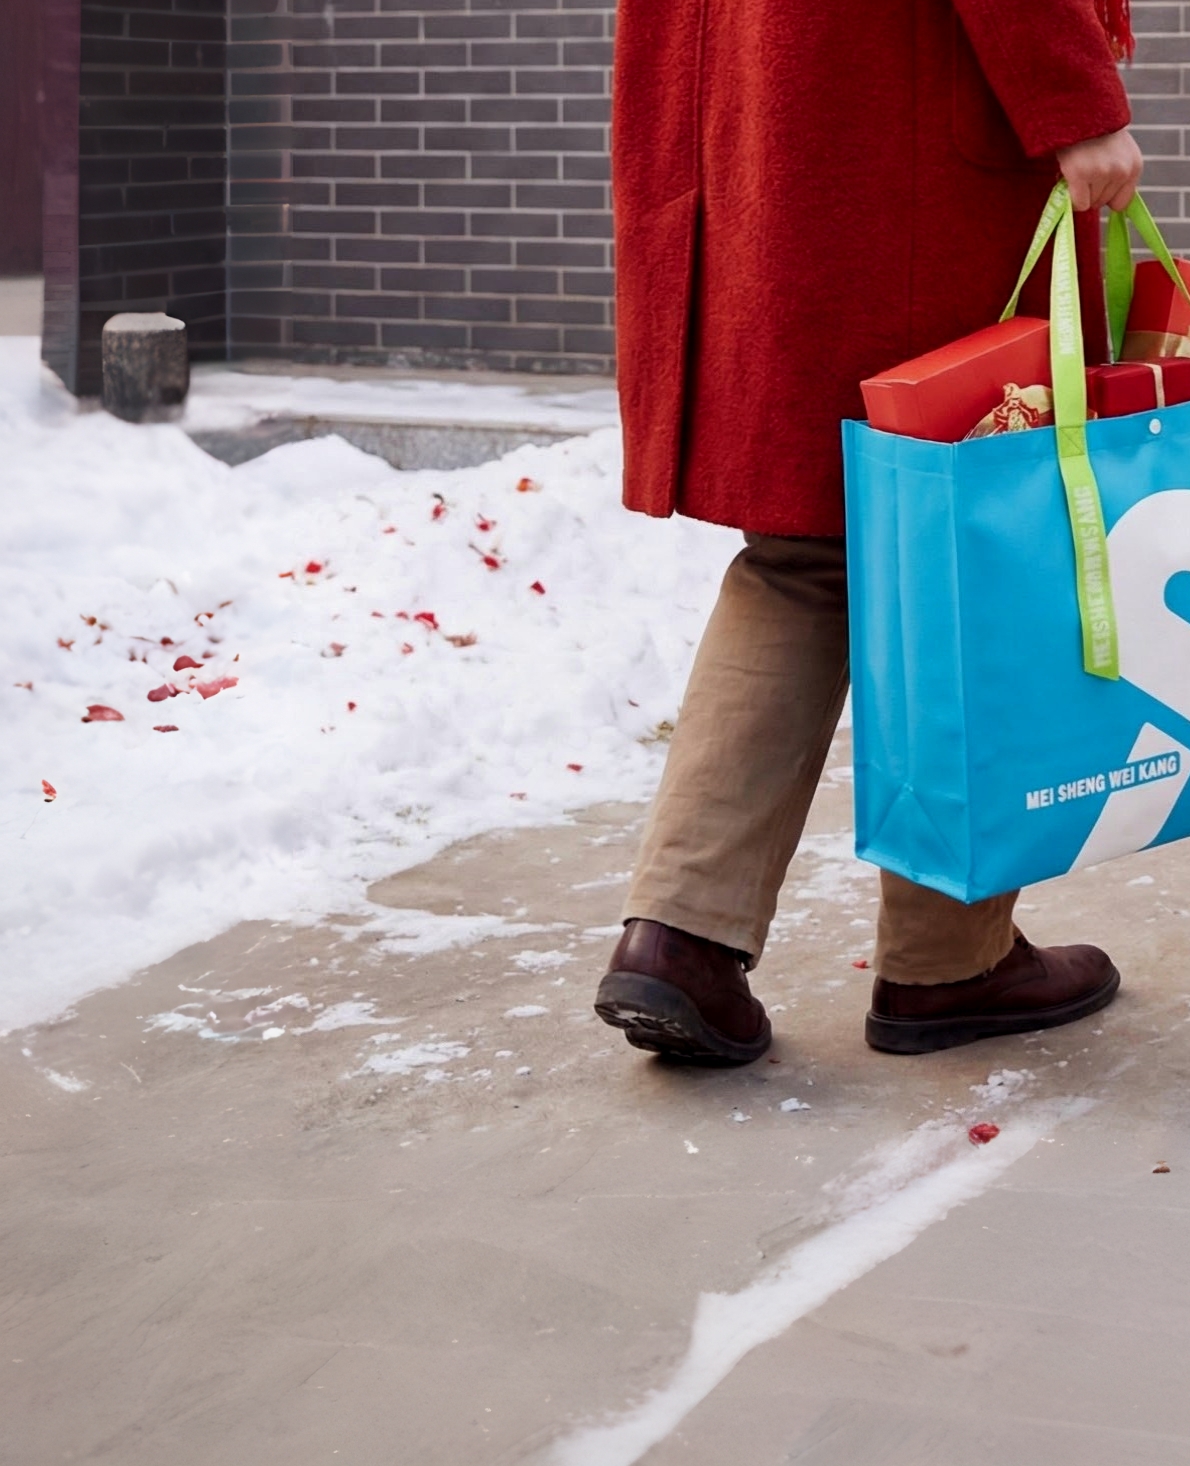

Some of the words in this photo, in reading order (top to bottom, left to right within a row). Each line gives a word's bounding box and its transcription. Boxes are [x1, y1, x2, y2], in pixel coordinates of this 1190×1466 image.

[1026, 787, 1054, 810] MEI
[1058, 773, 1106, 803] SHENG
[1109, 765, 1135, 788] WEI
[1138, 755, 1178, 782] KANG
